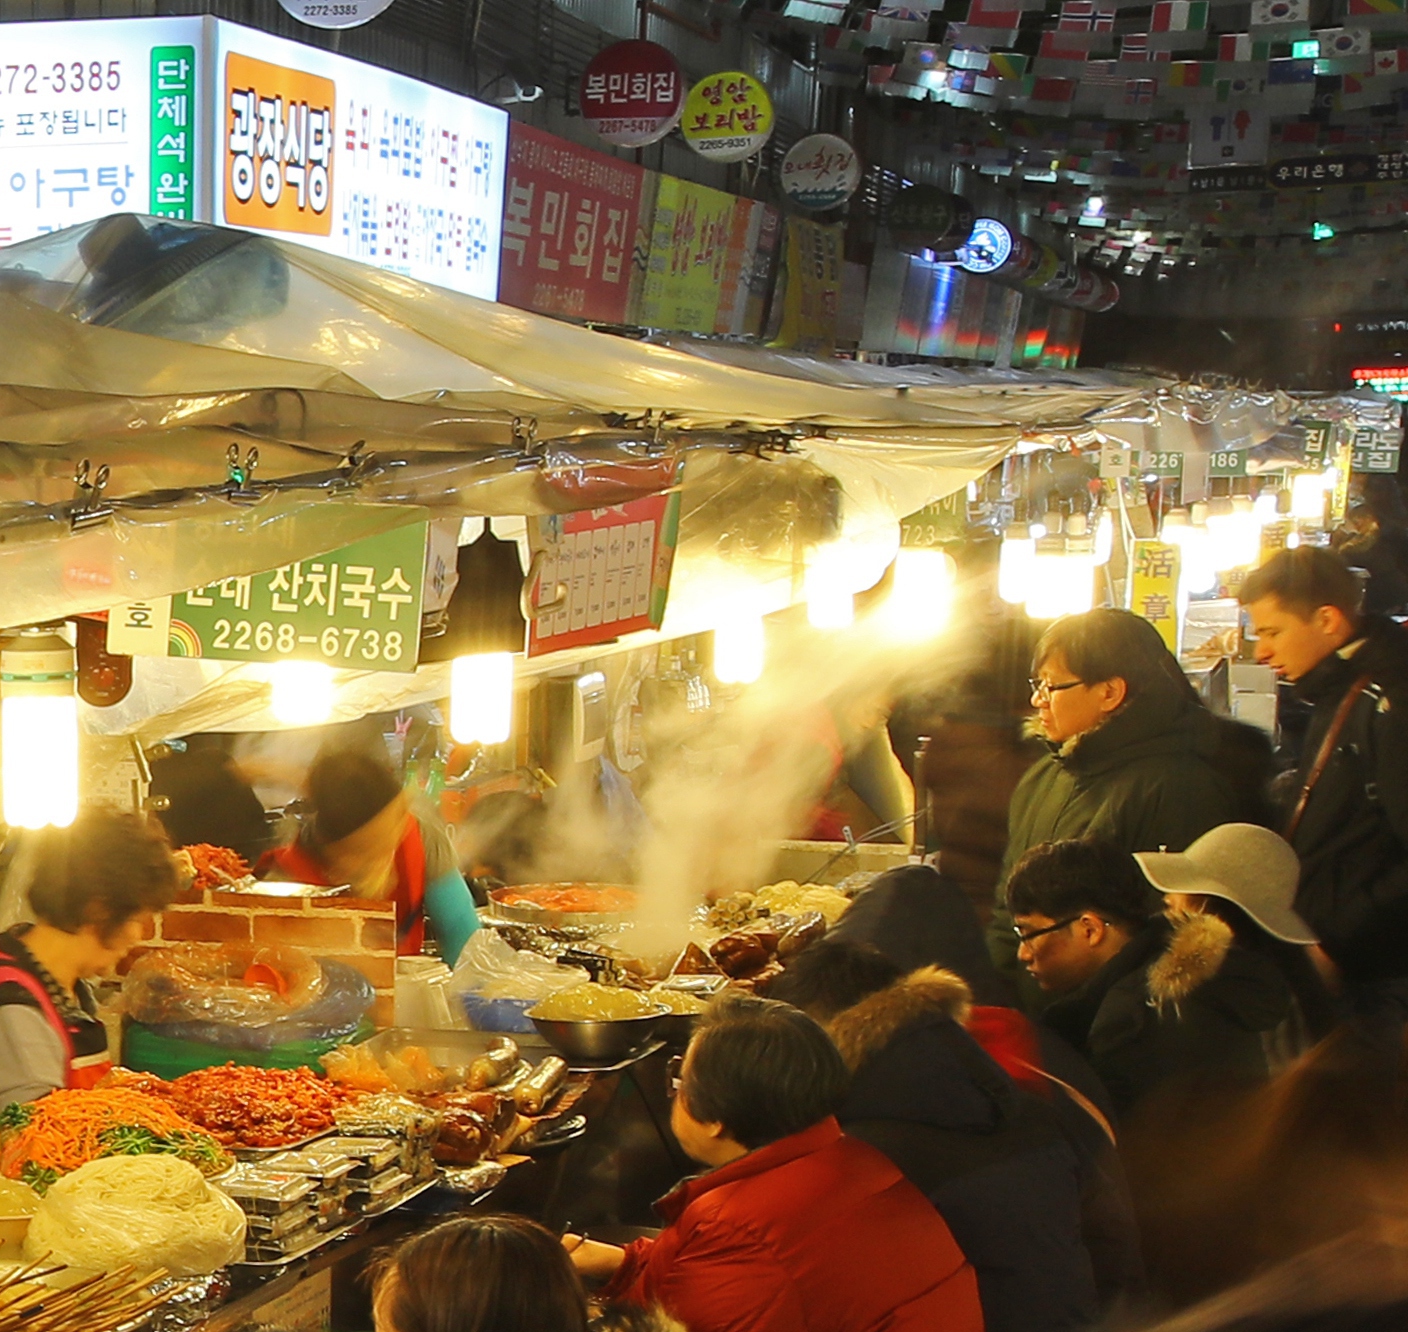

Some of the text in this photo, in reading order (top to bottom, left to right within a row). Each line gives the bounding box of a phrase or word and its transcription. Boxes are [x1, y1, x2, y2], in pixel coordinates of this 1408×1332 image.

[304, 5, 358, 16] 2272-3385
[585, 71, 675, 104] 복민회집
[702, 77, 753, 106] 영암
[15, 107, 127, 136] 포장됩니다
[156, 59, 190, 163] 단체석
[689, 105, 765, 133] 보리밥
[230, 87, 331, 215] 광장식당
[699, 138, 752, 150] 2265-9351
[10, 165, 135, 209] 아구탕
[1276, 163, 1344, 179] 우리은행
[502, 178, 629, 284] 복민회집
[268, 562, 413, 621] 잔치국수
[213, 619, 402, 661] 2268-6738
